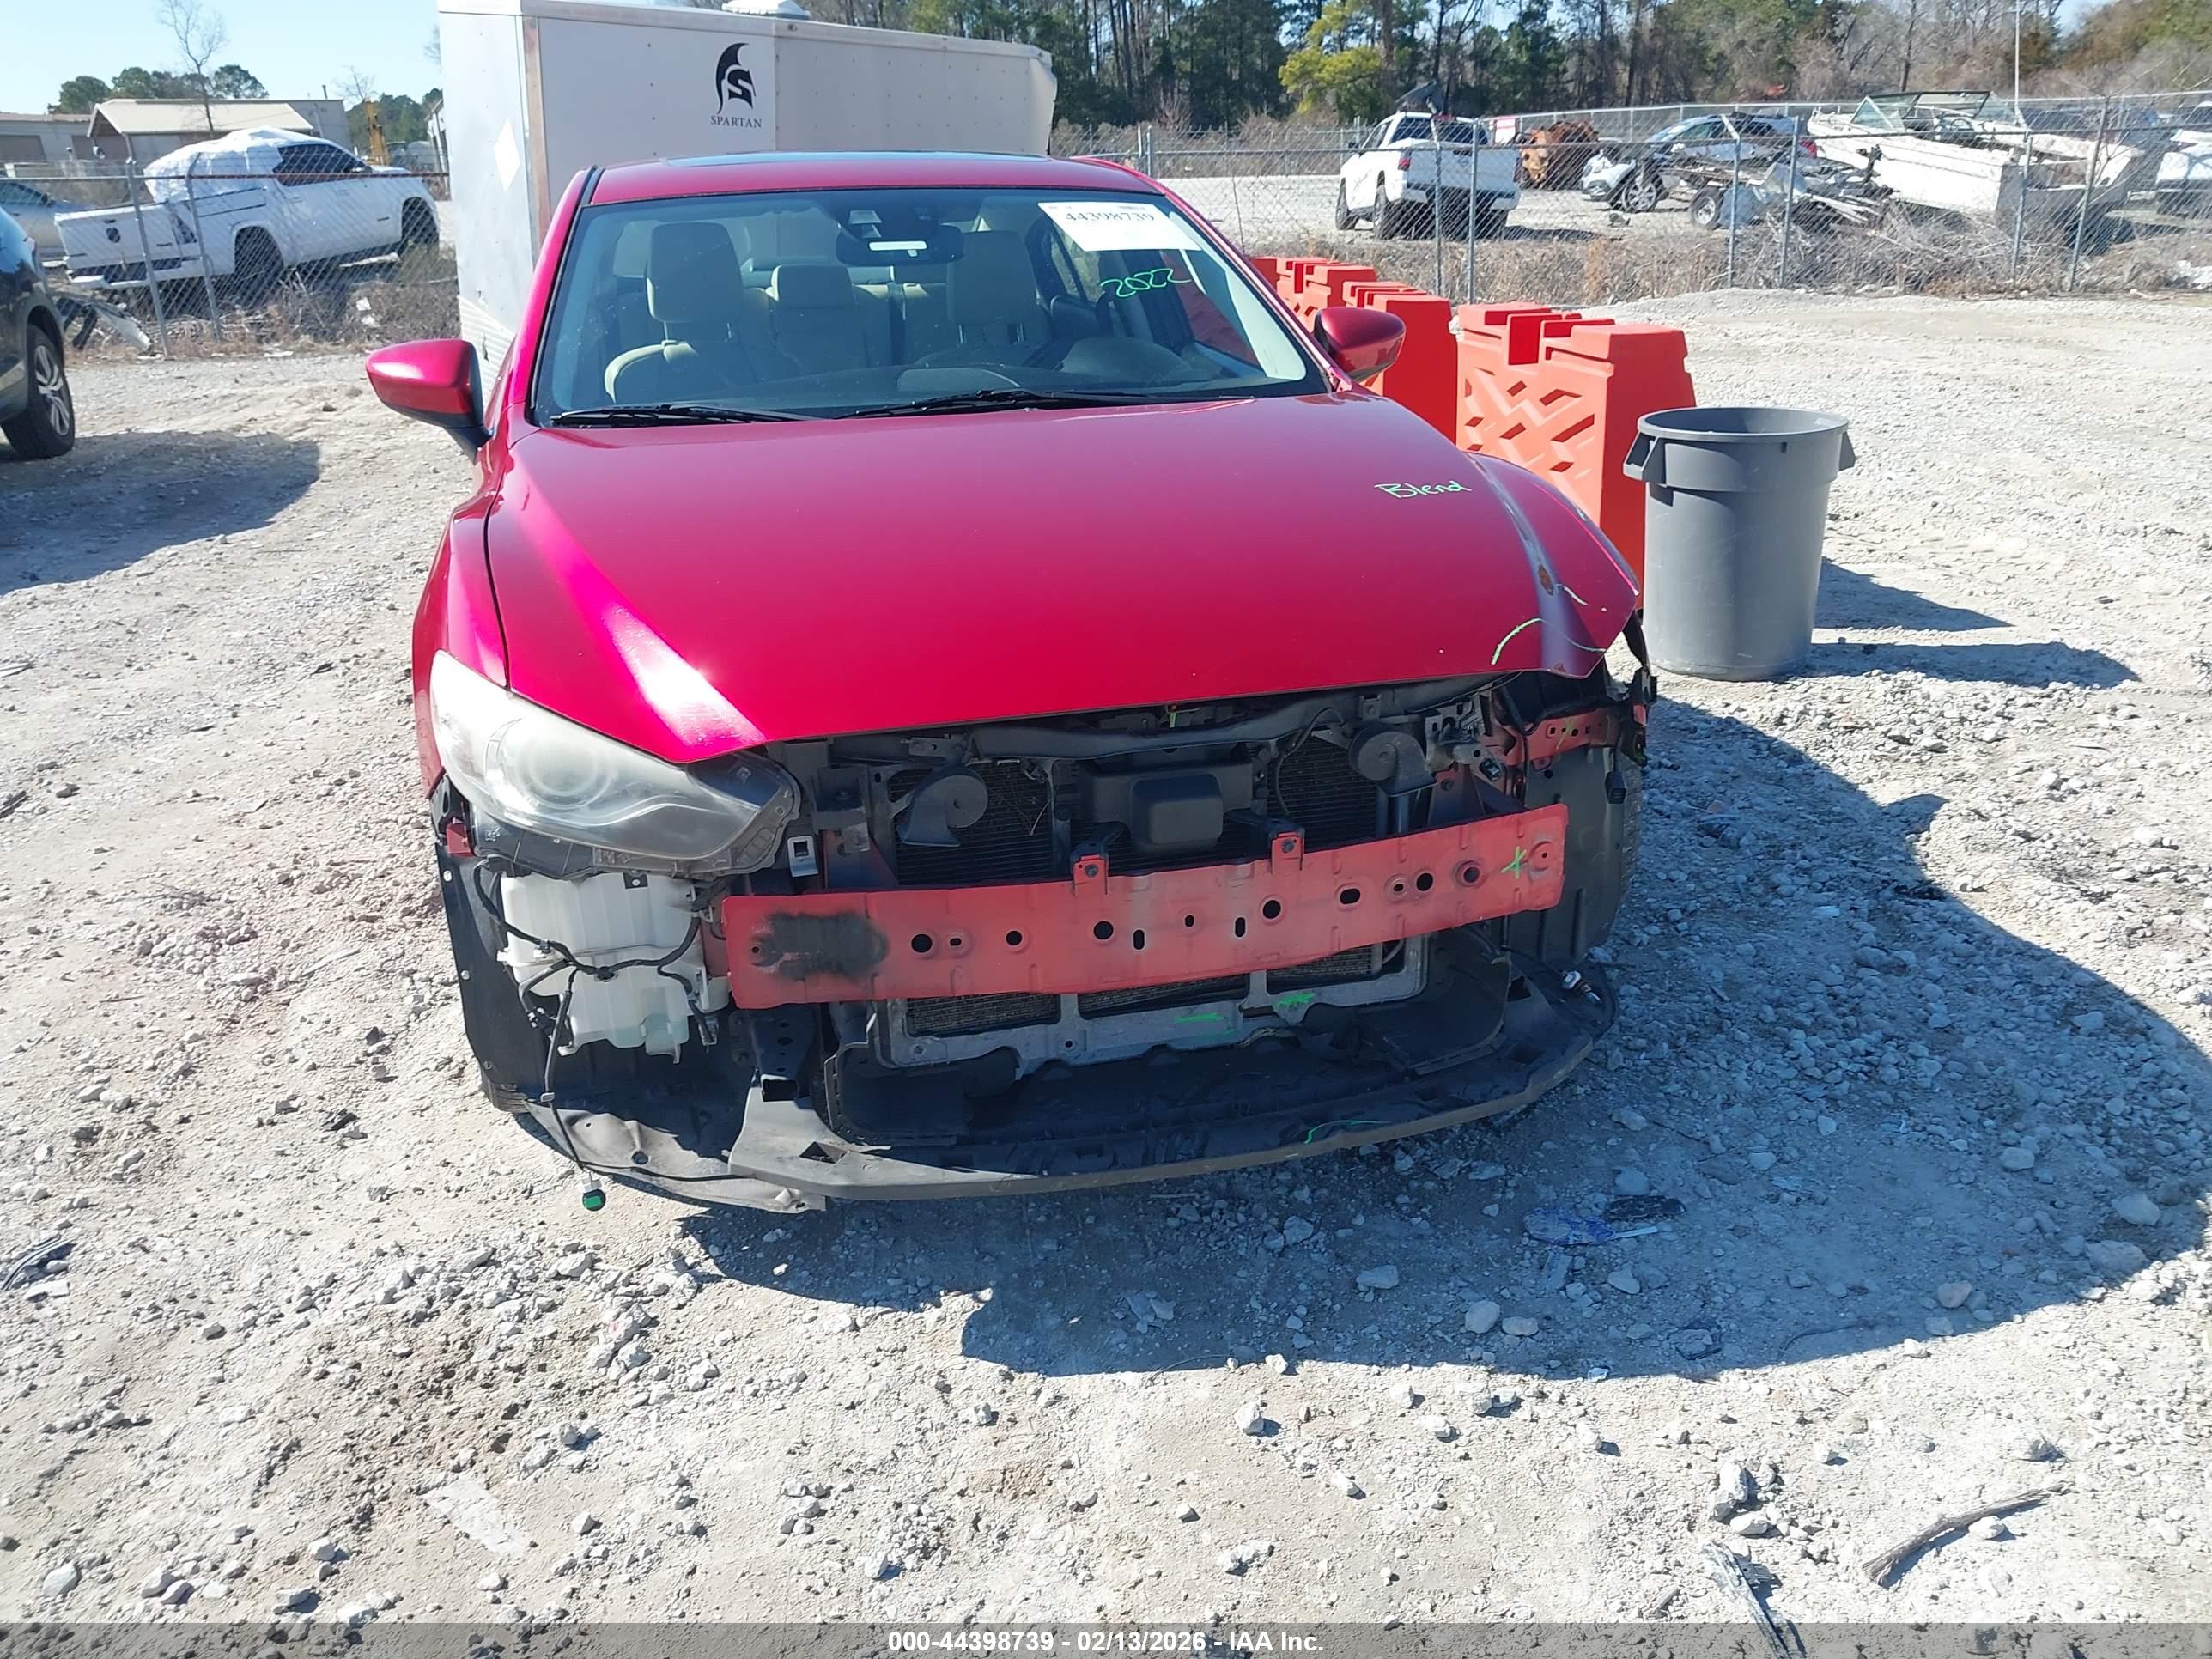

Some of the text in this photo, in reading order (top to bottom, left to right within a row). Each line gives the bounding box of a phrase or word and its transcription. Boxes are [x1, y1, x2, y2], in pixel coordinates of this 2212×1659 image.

[710, 115, 763, 129] SPARTAN
[1099, 268, 1193, 298] 2022
[1374, 480, 1472, 499] Blend
